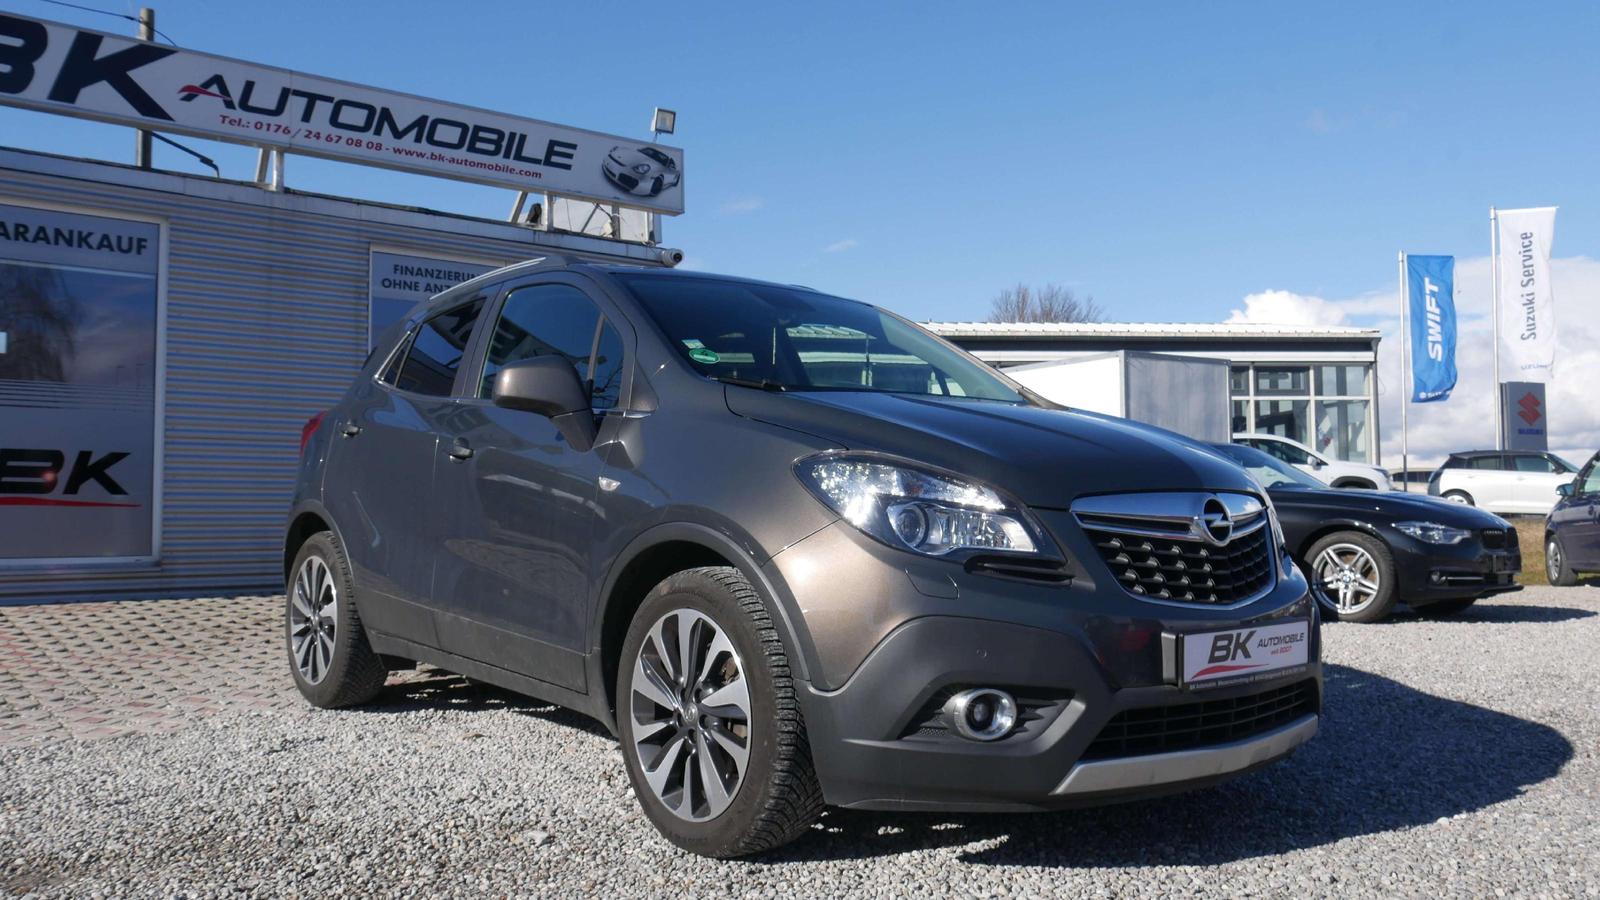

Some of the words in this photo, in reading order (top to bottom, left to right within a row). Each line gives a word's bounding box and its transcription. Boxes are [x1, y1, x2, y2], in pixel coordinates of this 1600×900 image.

[179, 74, 578, 171] AUTOMOBILE
[219, 114, 251, 129] Tel.:
[254, 121, 291, 135] 0176
[304, 130, 321, 140] 24
[325, 133, 342, 143] 67
[346, 137, 362, 147] 08
[366, 141, 382, 151] 08
[393, 148, 542, 179] www.bk-automobile.com
[381, 278, 421, 292] OHNE
[1520, 231, 1536, 288] Service
[1424, 276, 1443, 362] SWIFT
[1521, 291, 1537, 341] Suzuki
[1208, 630, 1256, 664] BK
[1257, 632, 1305, 648] AUTOMOBILE
